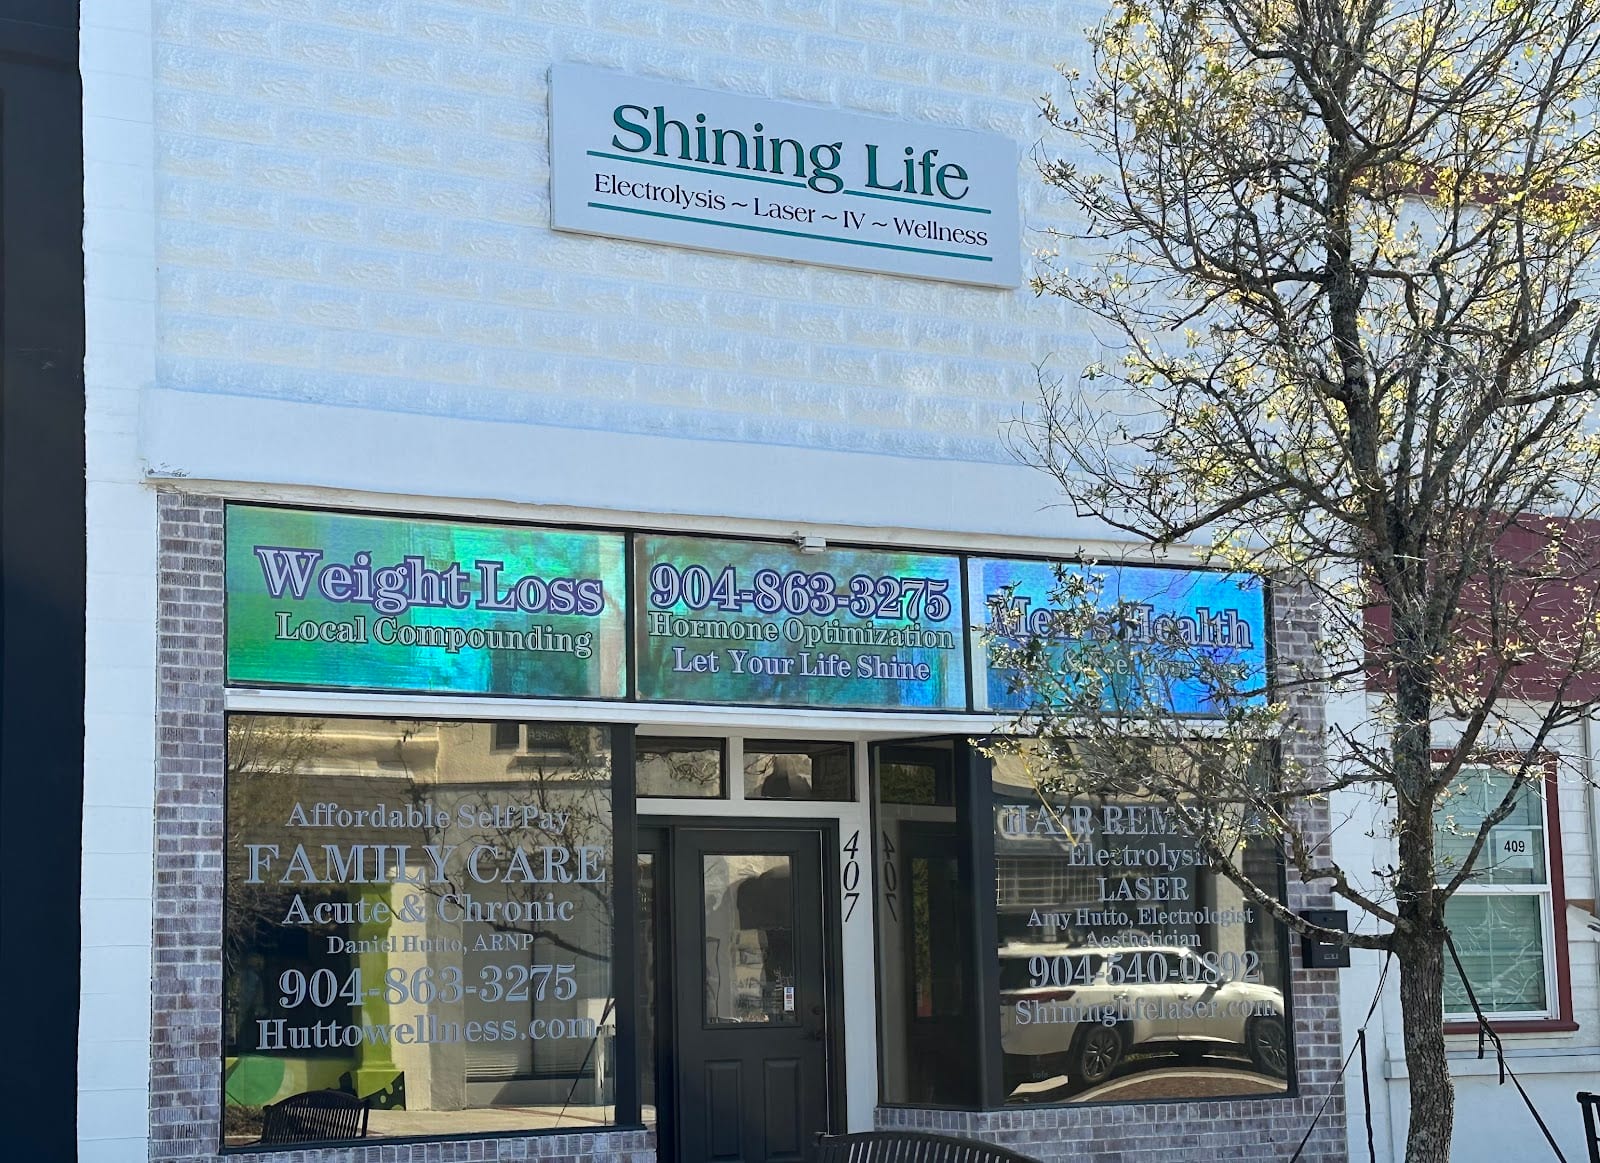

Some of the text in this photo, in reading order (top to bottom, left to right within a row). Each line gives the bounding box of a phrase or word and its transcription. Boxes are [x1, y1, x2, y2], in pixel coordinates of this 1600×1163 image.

[612, 104, 969, 200] Shining Life
[594, 173, 726, 211] Electrolysis
[753, 197, 816, 224] Laser
[843, 211, 866, 230] IV
[893, 217, 988, 247] Wellness
[254, 546, 605, 616] Weight Loss
[650, 562, 952, 622] 904-863-3275
[275, 611, 594, 658] Local Compounding
[649, 610, 955, 649] Hormone Optimization
[672, 648, 931, 681] Let Your Life Shine
[285, 802, 450, 829] Affordable
[518, 805, 570, 835] Pay
[244, 844, 606, 883] FAMILY CARE
[1504, 840, 1525, 853] 409
[843, 830, 860, 923] 407
[1097, 876, 1190, 902] LASER
[282, 893, 575, 926] Acute & Chronic
[1027, 906, 1255, 930] Amy Hutto, Electrologist
[327, 933, 534, 956] Daniel Hutto, ARNP
[1086, 930, 1202, 948] Aesthetician
[278, 964, 578, 1009] 904-863-3275
[1028, 950, 1261, 987] 904-540-0892
[255, 1013, 597, 1051] Huttowellness.com
[1015, 999, 1278, 1028] Shininglifelaser.com
